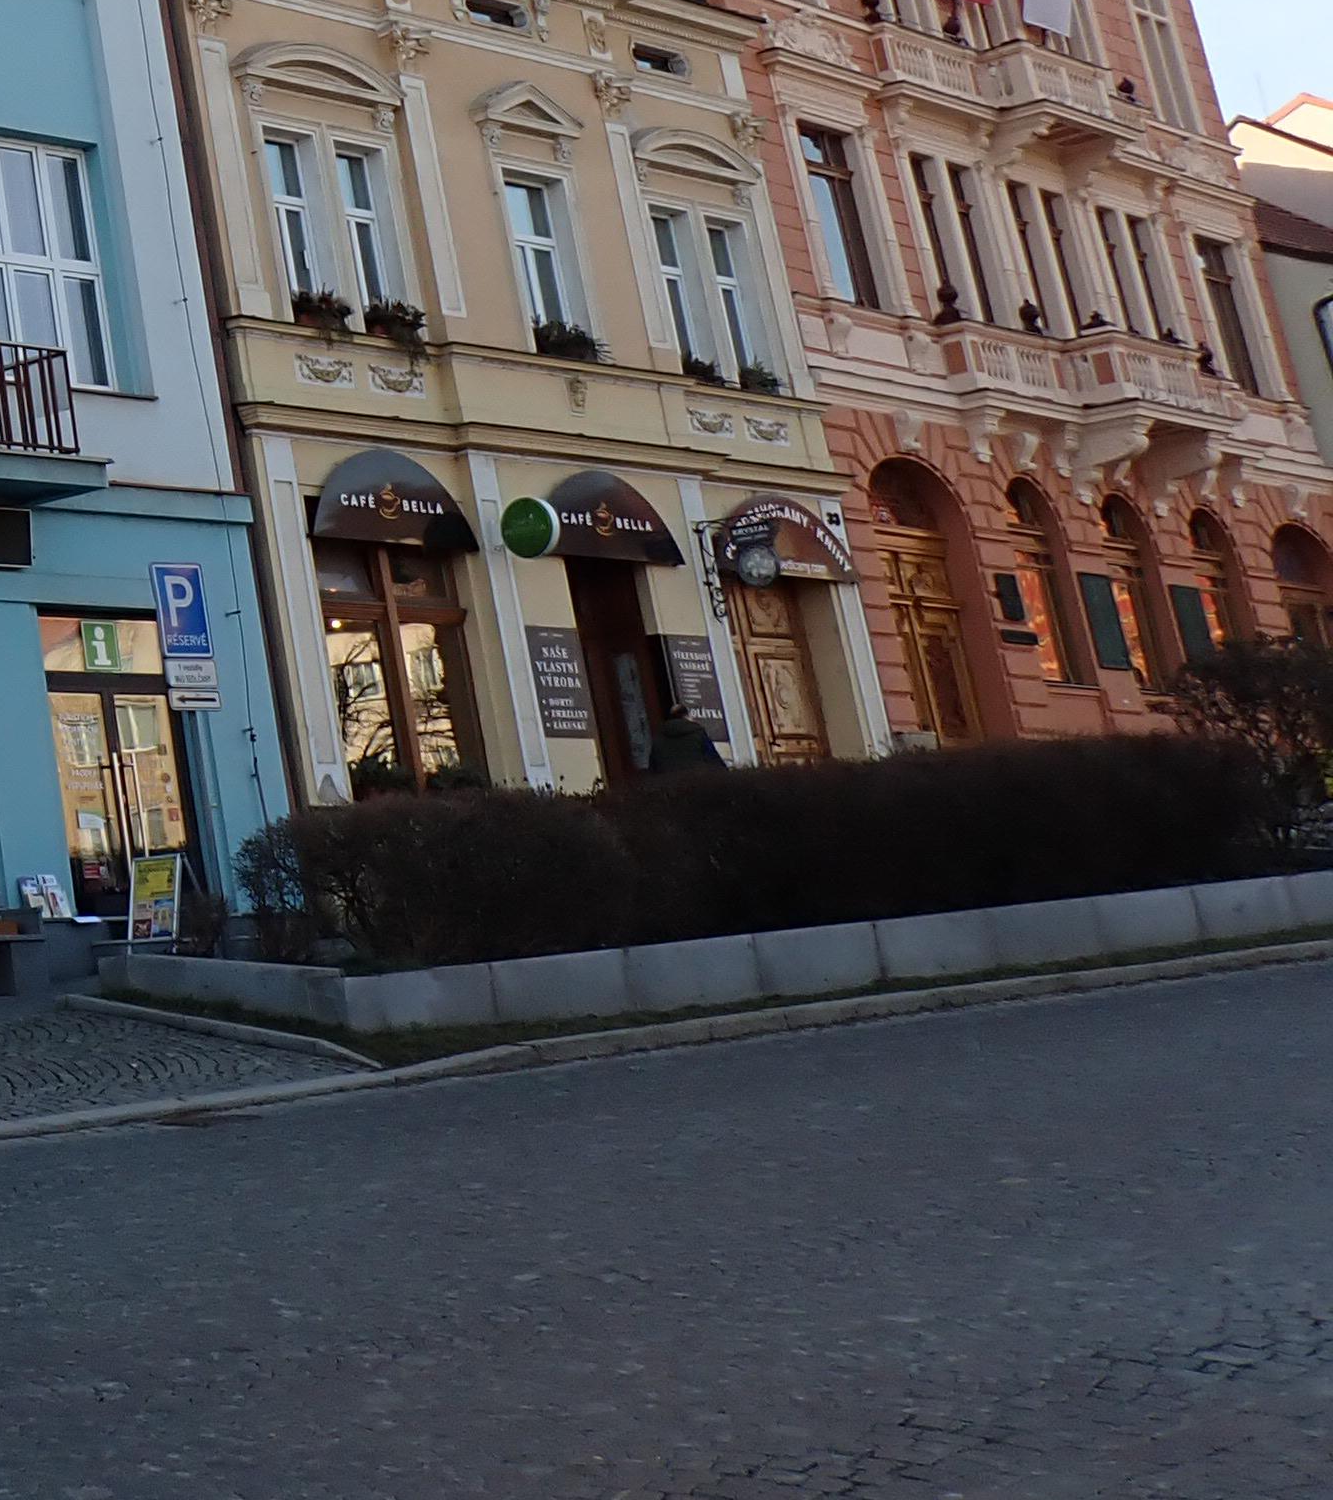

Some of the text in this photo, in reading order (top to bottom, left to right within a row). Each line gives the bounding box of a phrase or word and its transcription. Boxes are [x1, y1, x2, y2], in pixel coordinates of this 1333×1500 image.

[340, 493, 444, 514] CAFÉ BELLA
[561, 511, 653, 531] CAFÉ BELLA
[816, 528, 852, 572] KNIHY
[164, 575, 194, 627] P
[166, 632, 208, 647] RÉSERVÉ
[541, 645, 568, 659] NAŠE
[535, 660, 579, 674] VLASTNÍ
[540, 673, 581, 688] VÝROBA
